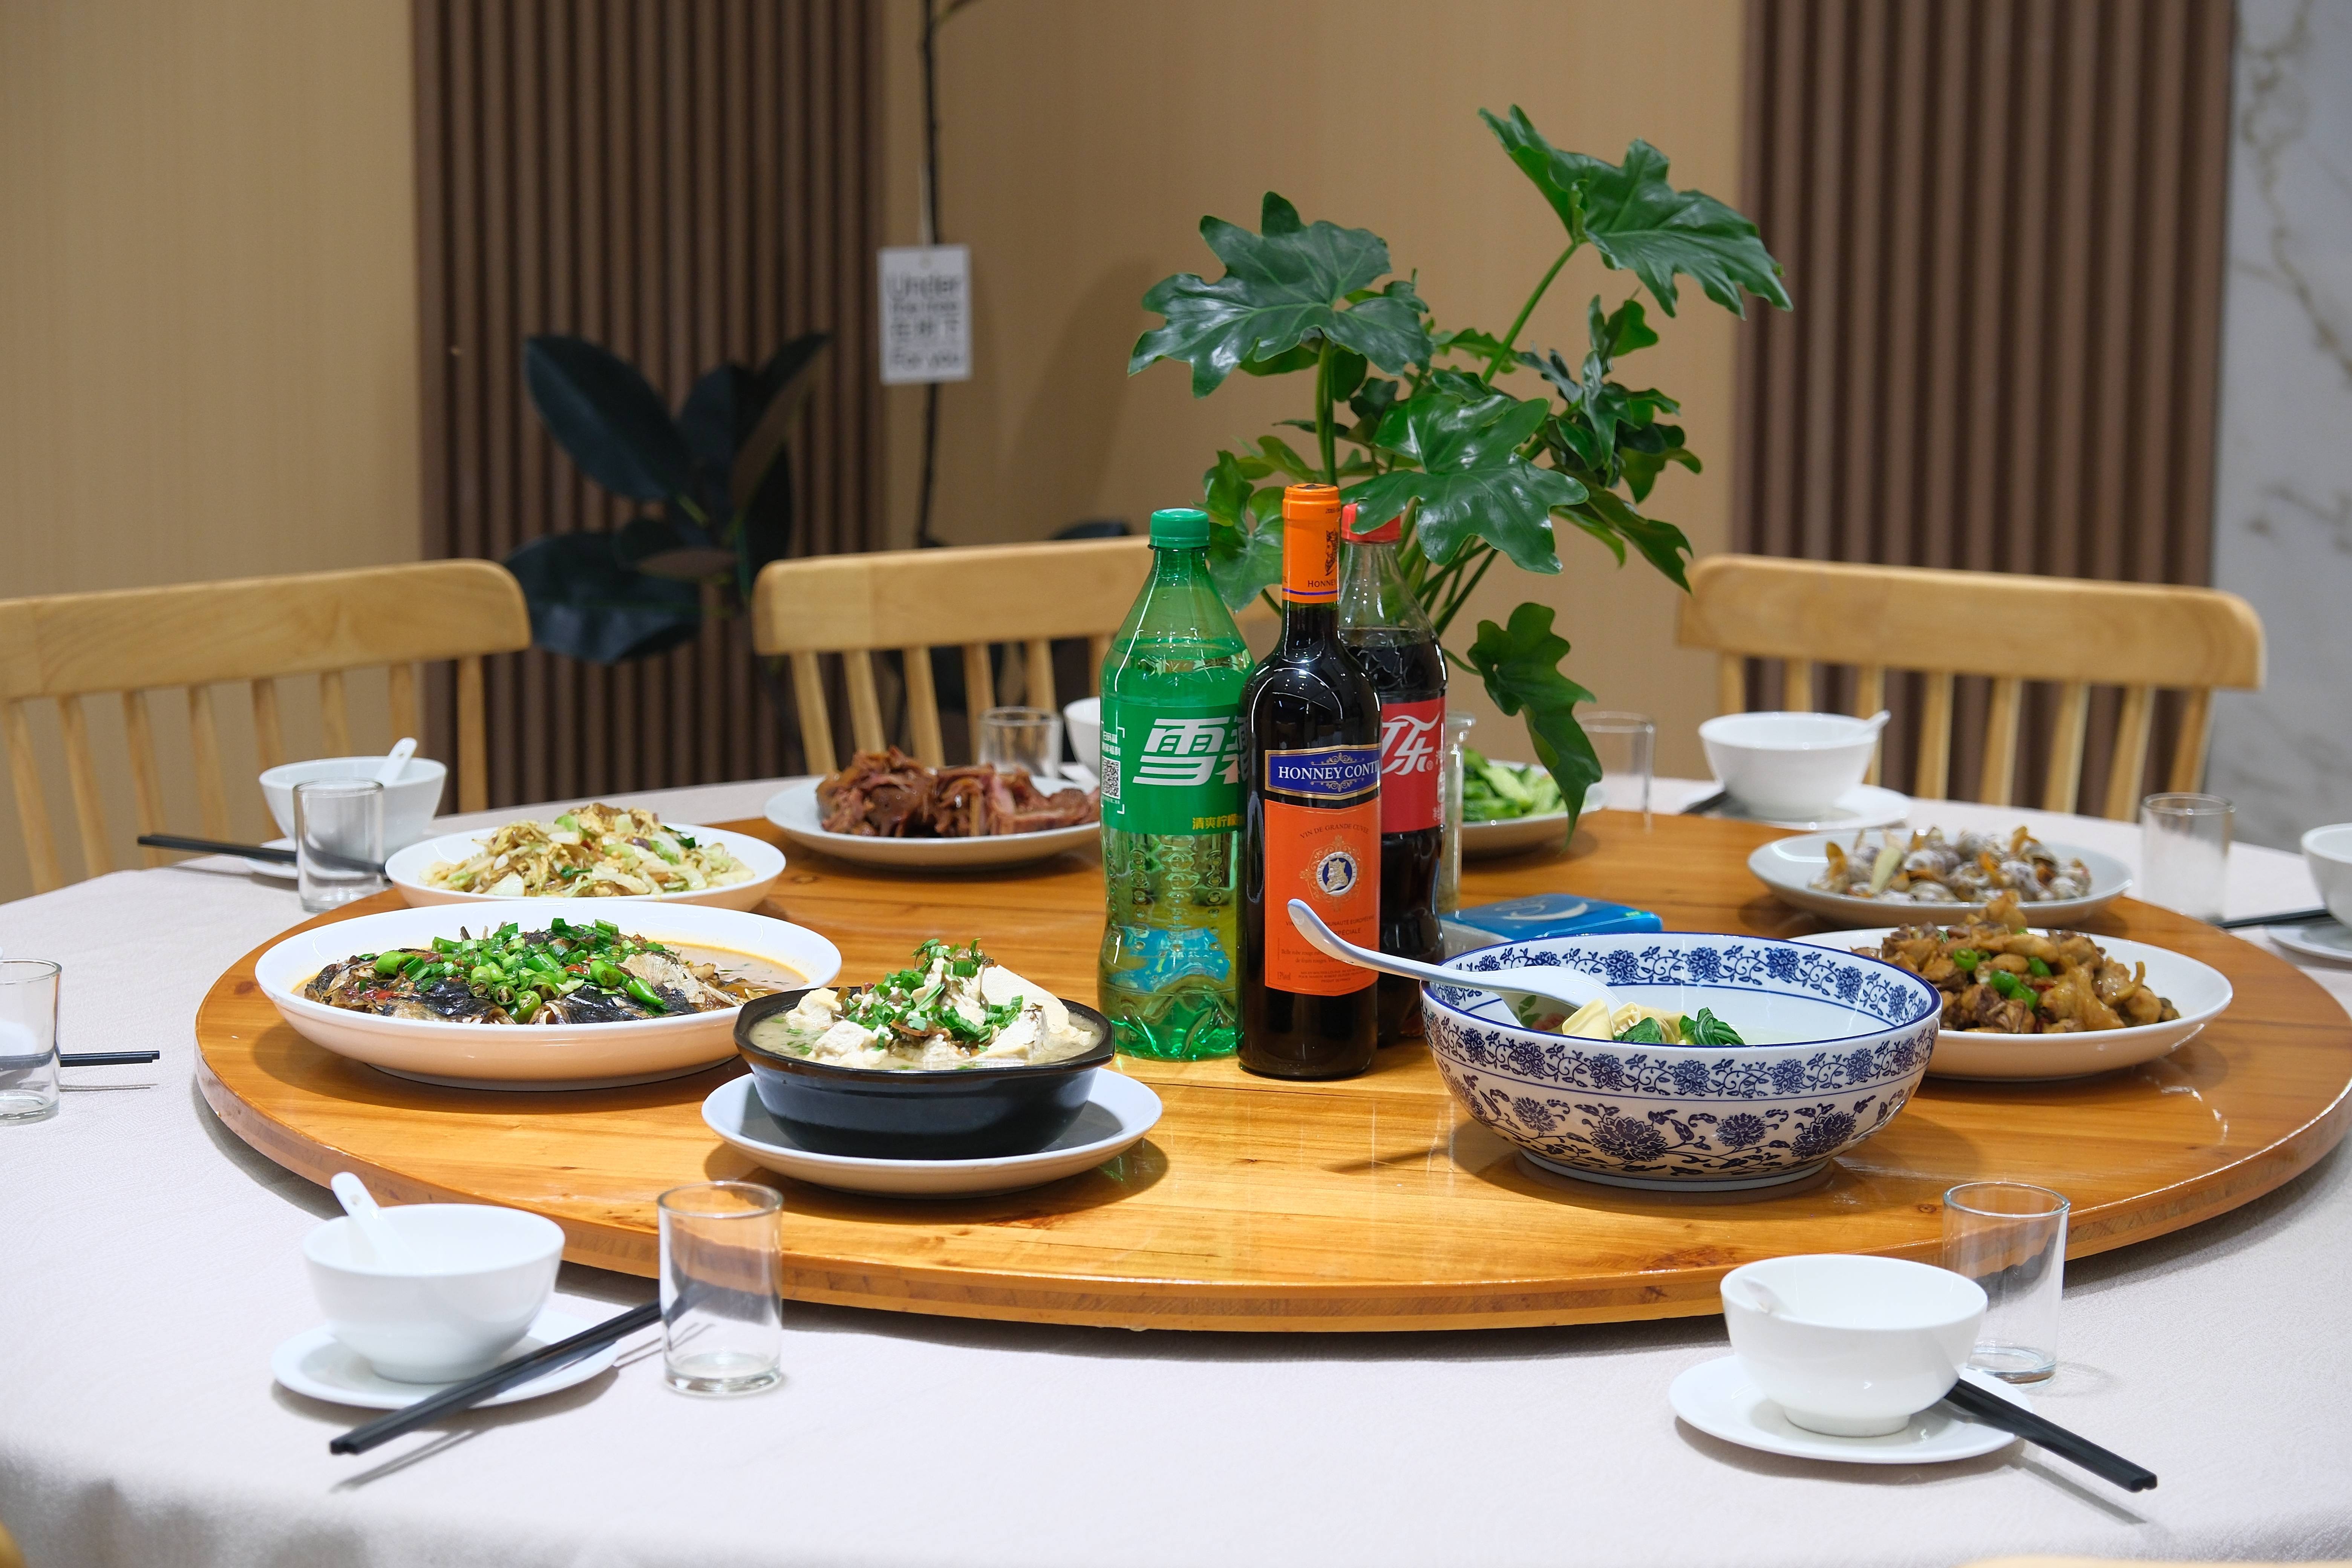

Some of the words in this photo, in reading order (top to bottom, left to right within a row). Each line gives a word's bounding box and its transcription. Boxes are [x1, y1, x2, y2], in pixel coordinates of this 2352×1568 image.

[888, 272, 962, 299] Under
[1278, 766, 1343, 780] HONNEY
[1300, 829, 1313, 838] VIN
